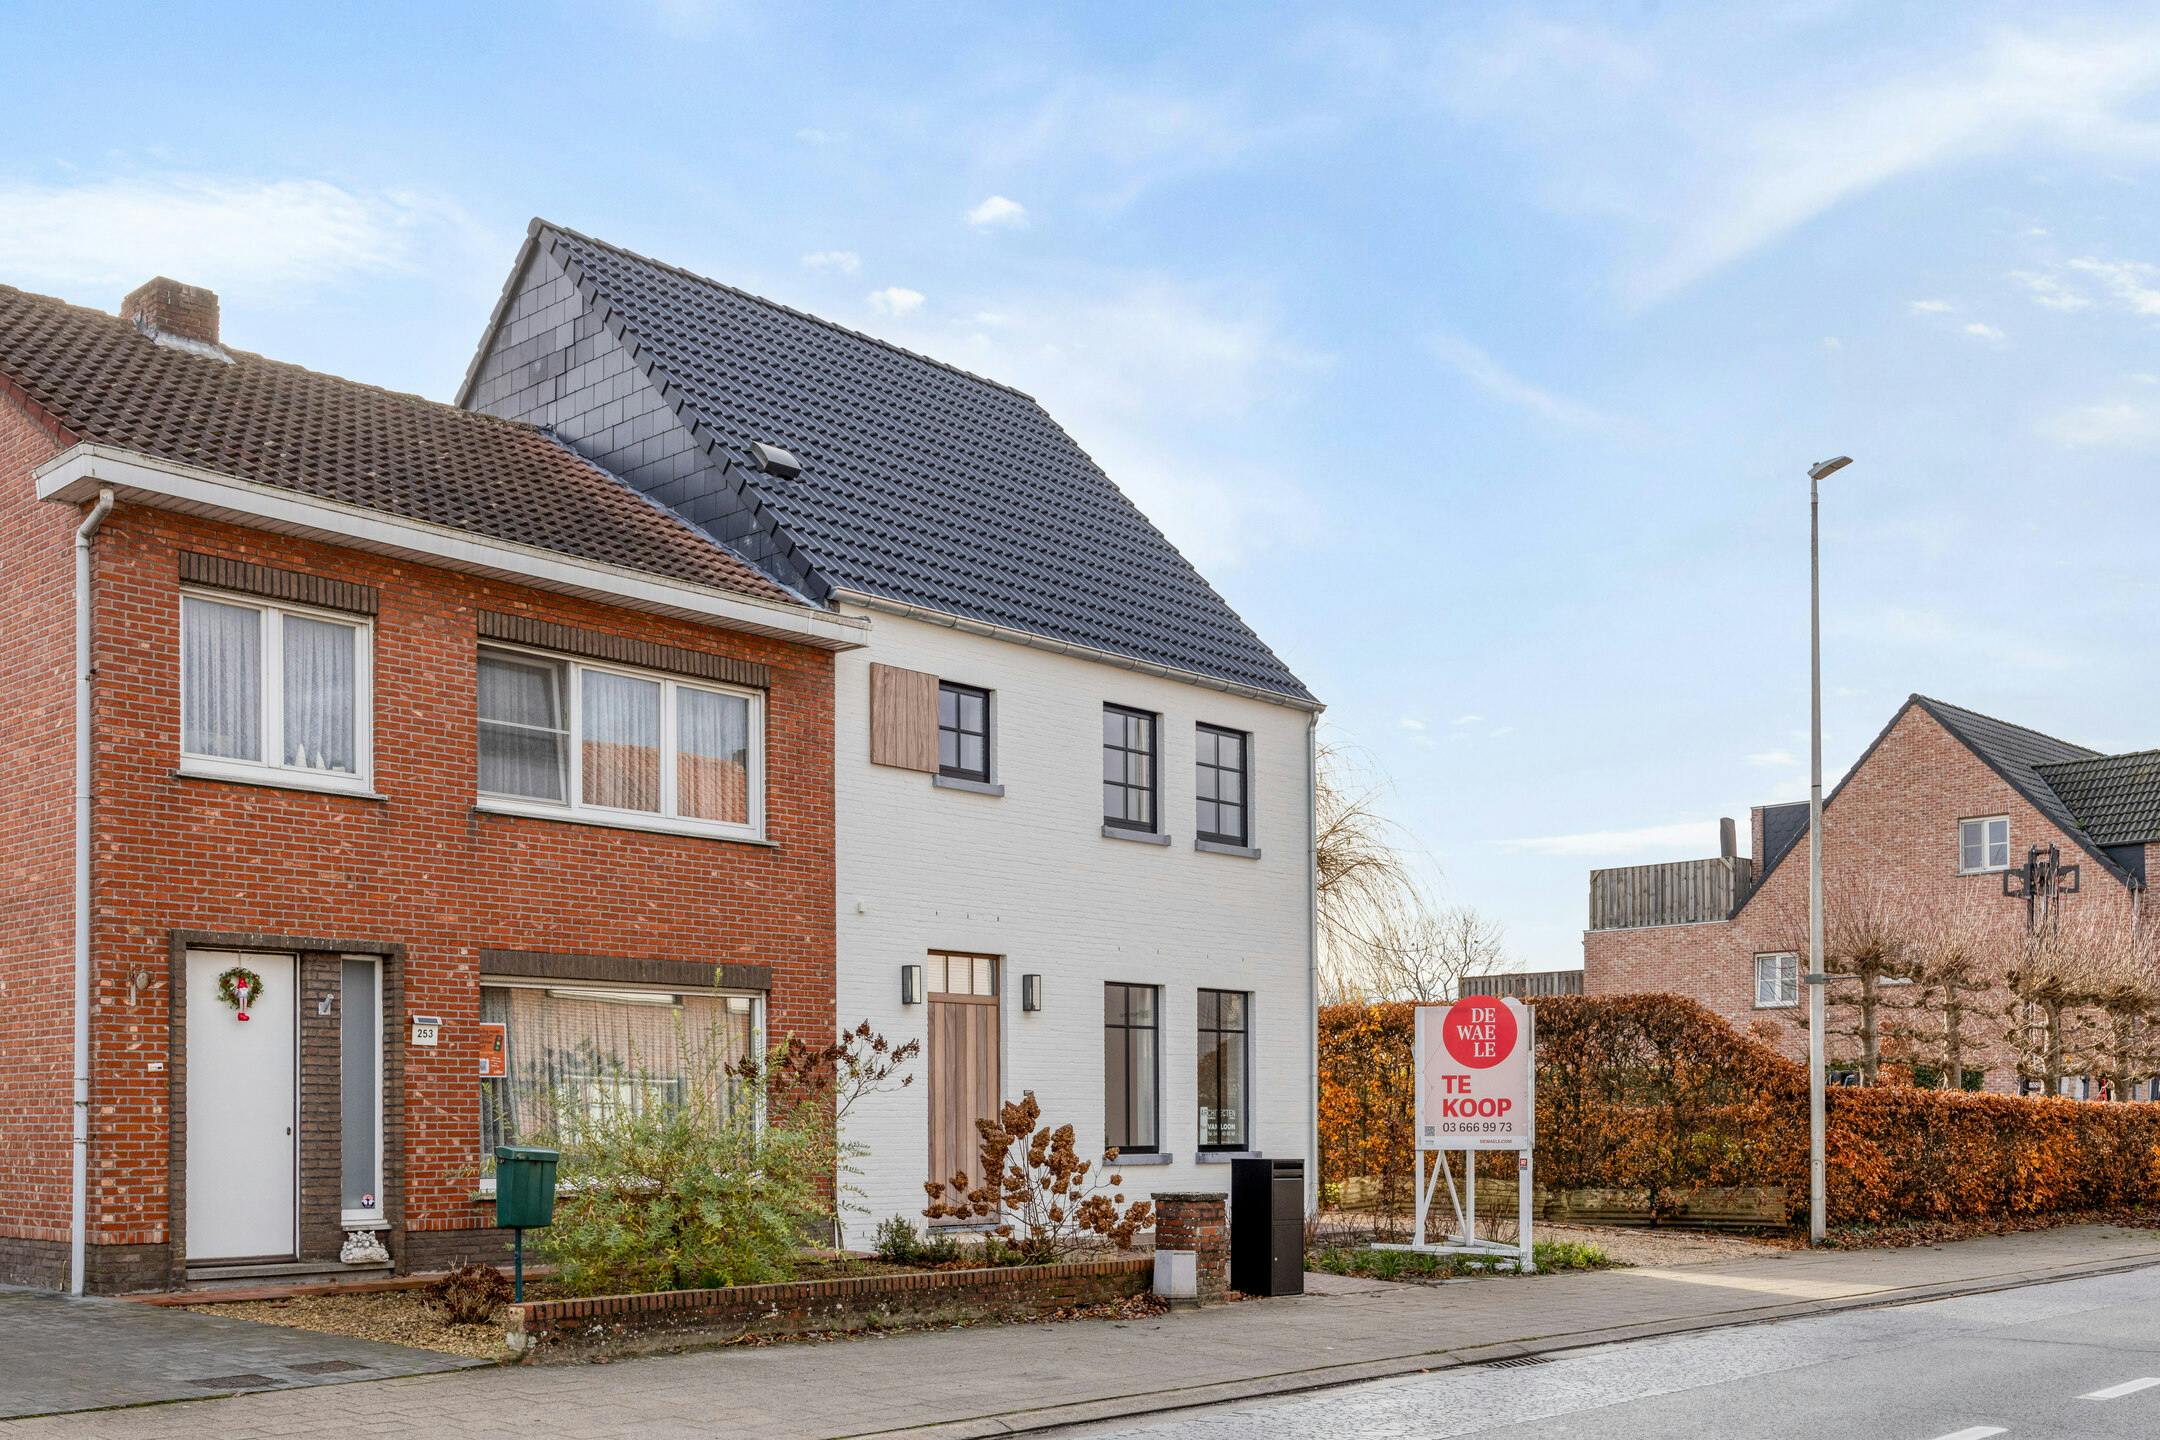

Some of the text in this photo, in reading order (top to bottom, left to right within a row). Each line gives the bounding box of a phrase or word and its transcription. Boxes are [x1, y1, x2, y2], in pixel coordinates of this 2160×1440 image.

[1471, 1007, 1496, 1023] DE
[417, 1029, 434, 1038] 253
[1456, 1025, 1496, 1040] WAE
[1473, 1042, 1496, 1057] LE
[1441, 1075, 1471, 1094] TE
[1201, 1109, 1236, 1117] ARCHIECTEN
[1442, 1098, 1512, 1118] KOOP
[1442, 1122, 1512, 1133] 03 666 99 73
